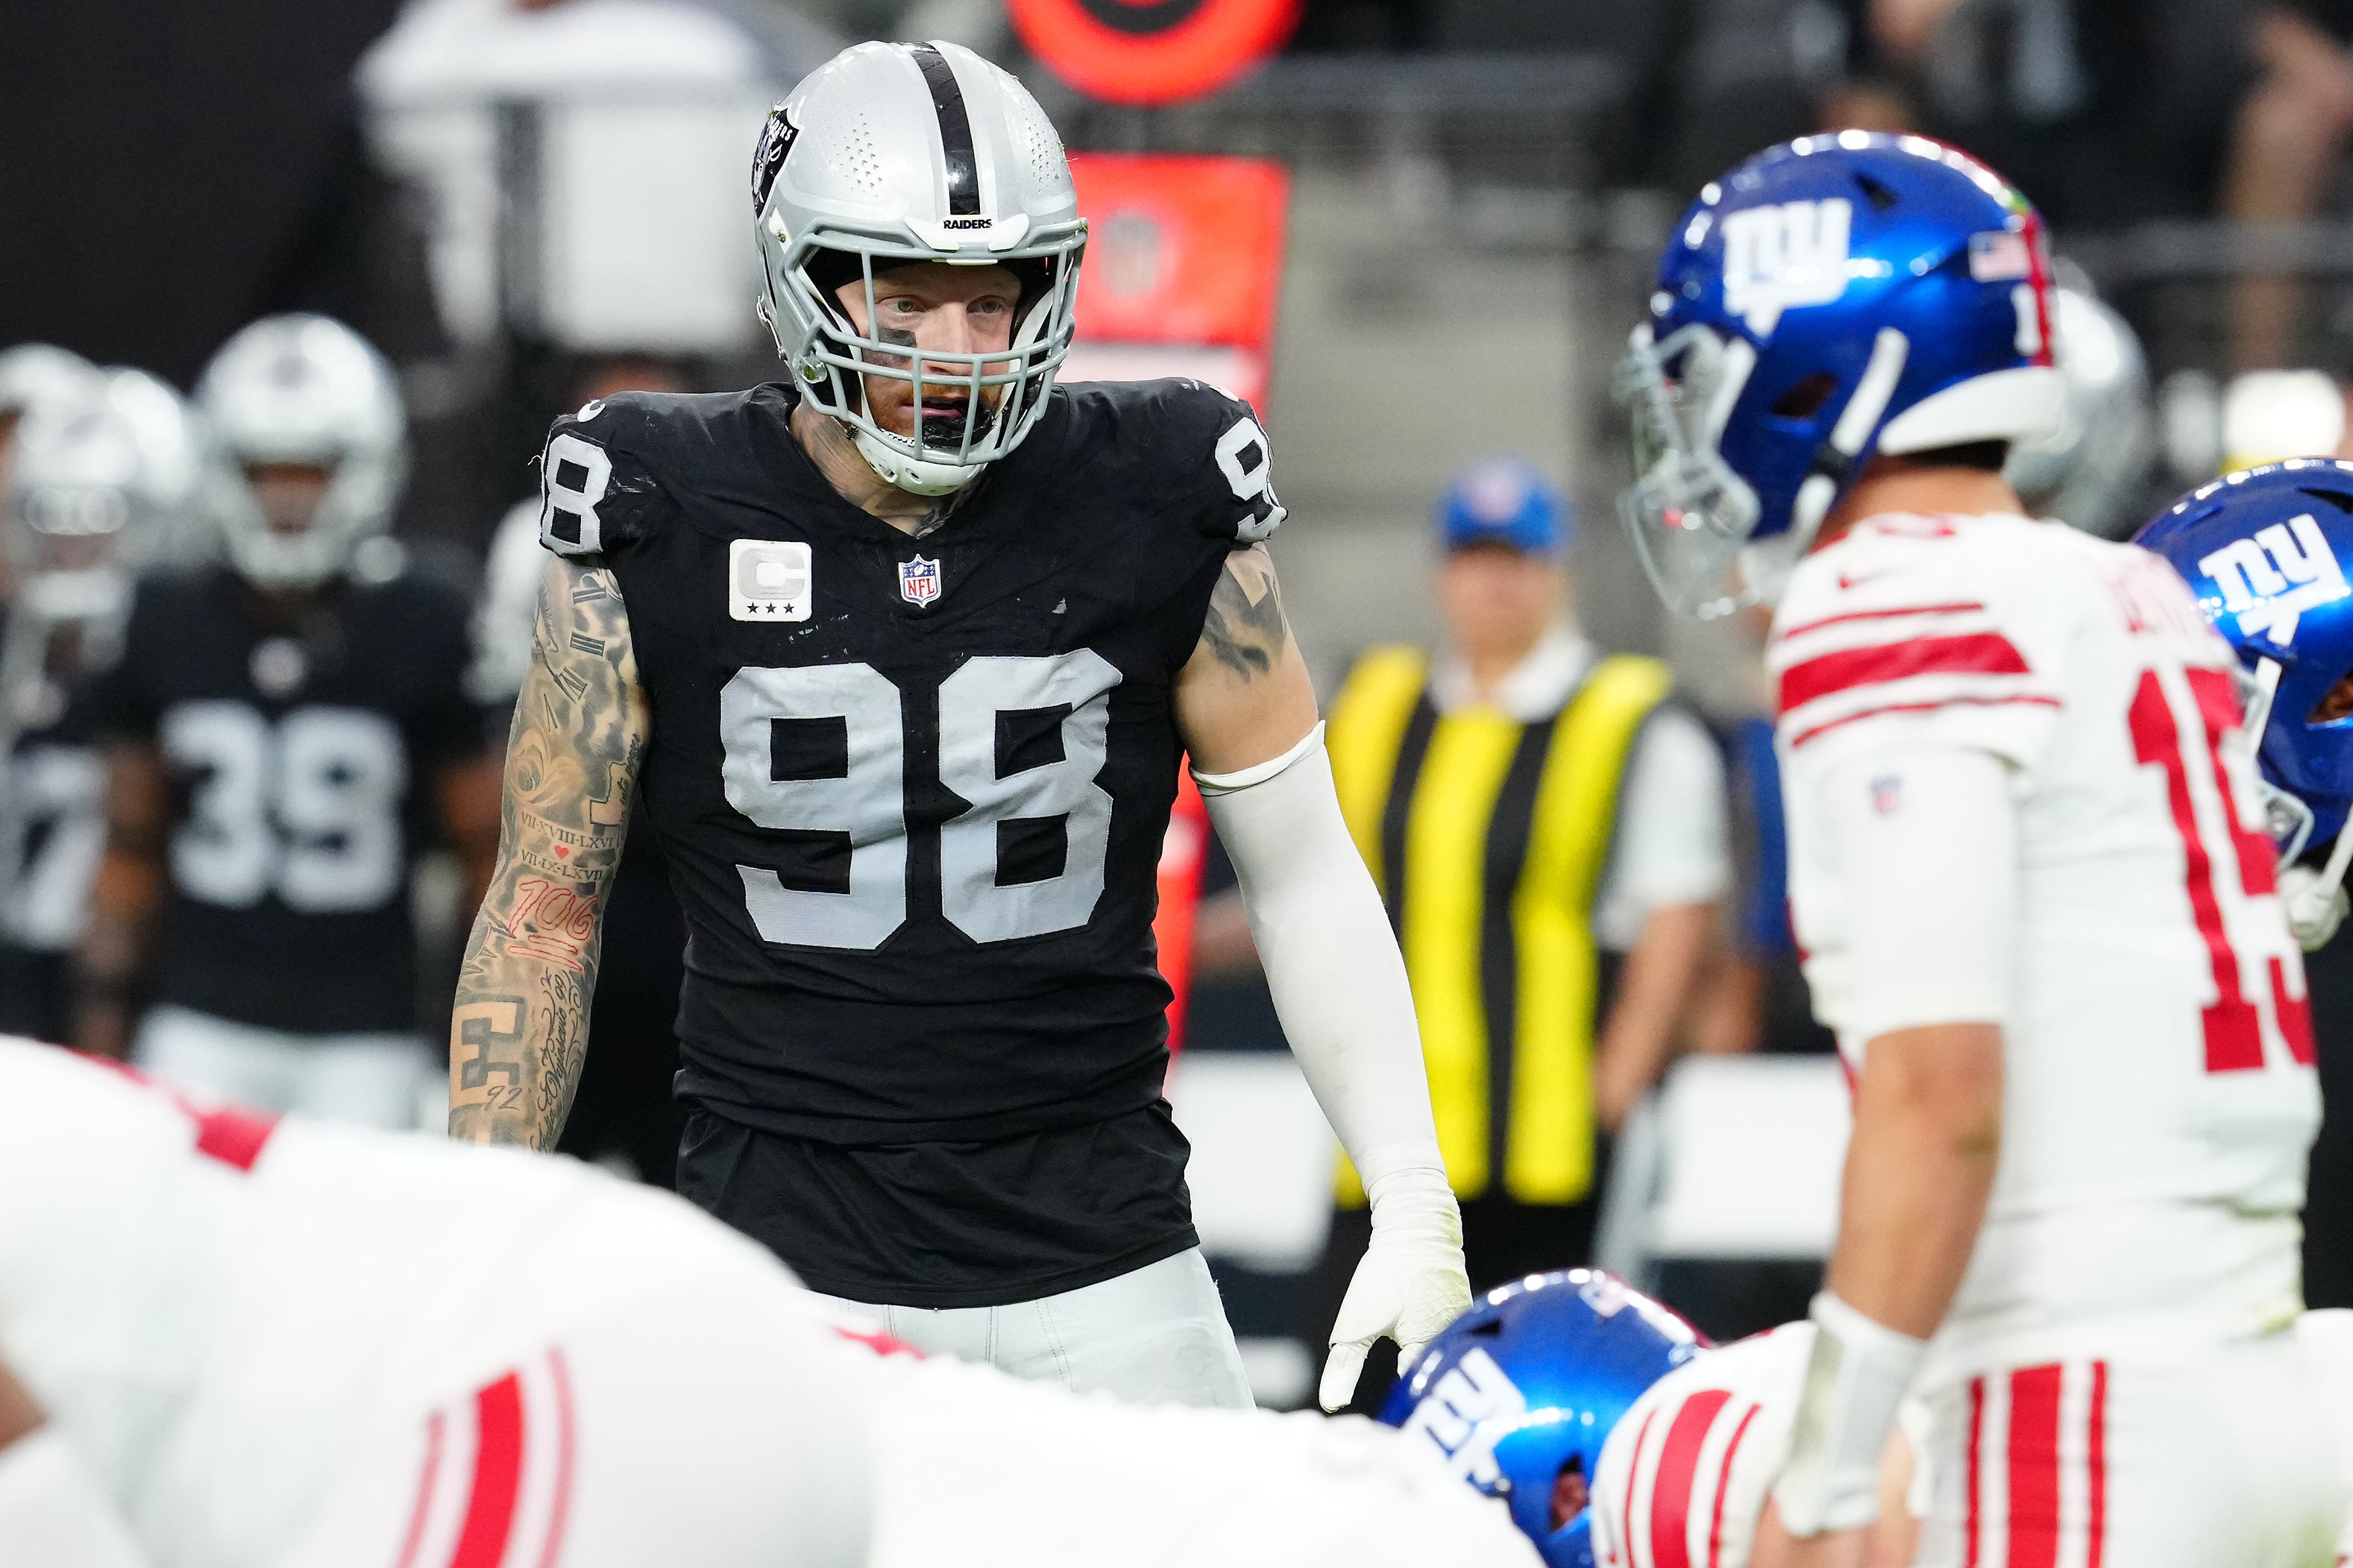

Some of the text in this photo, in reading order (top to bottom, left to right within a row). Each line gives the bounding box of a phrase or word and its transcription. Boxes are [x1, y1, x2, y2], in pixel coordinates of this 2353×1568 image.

[943, 218, 993, 230] RAIDERS
[541, 433, 612, 555] 8
[738, 548, 805, 599] C
[906, 577, 936, 597] NFL
[160, 699, 410, 913] 39
[720, 647, 1123, 951] 98
[484, 1085, 523, 1112] 92
